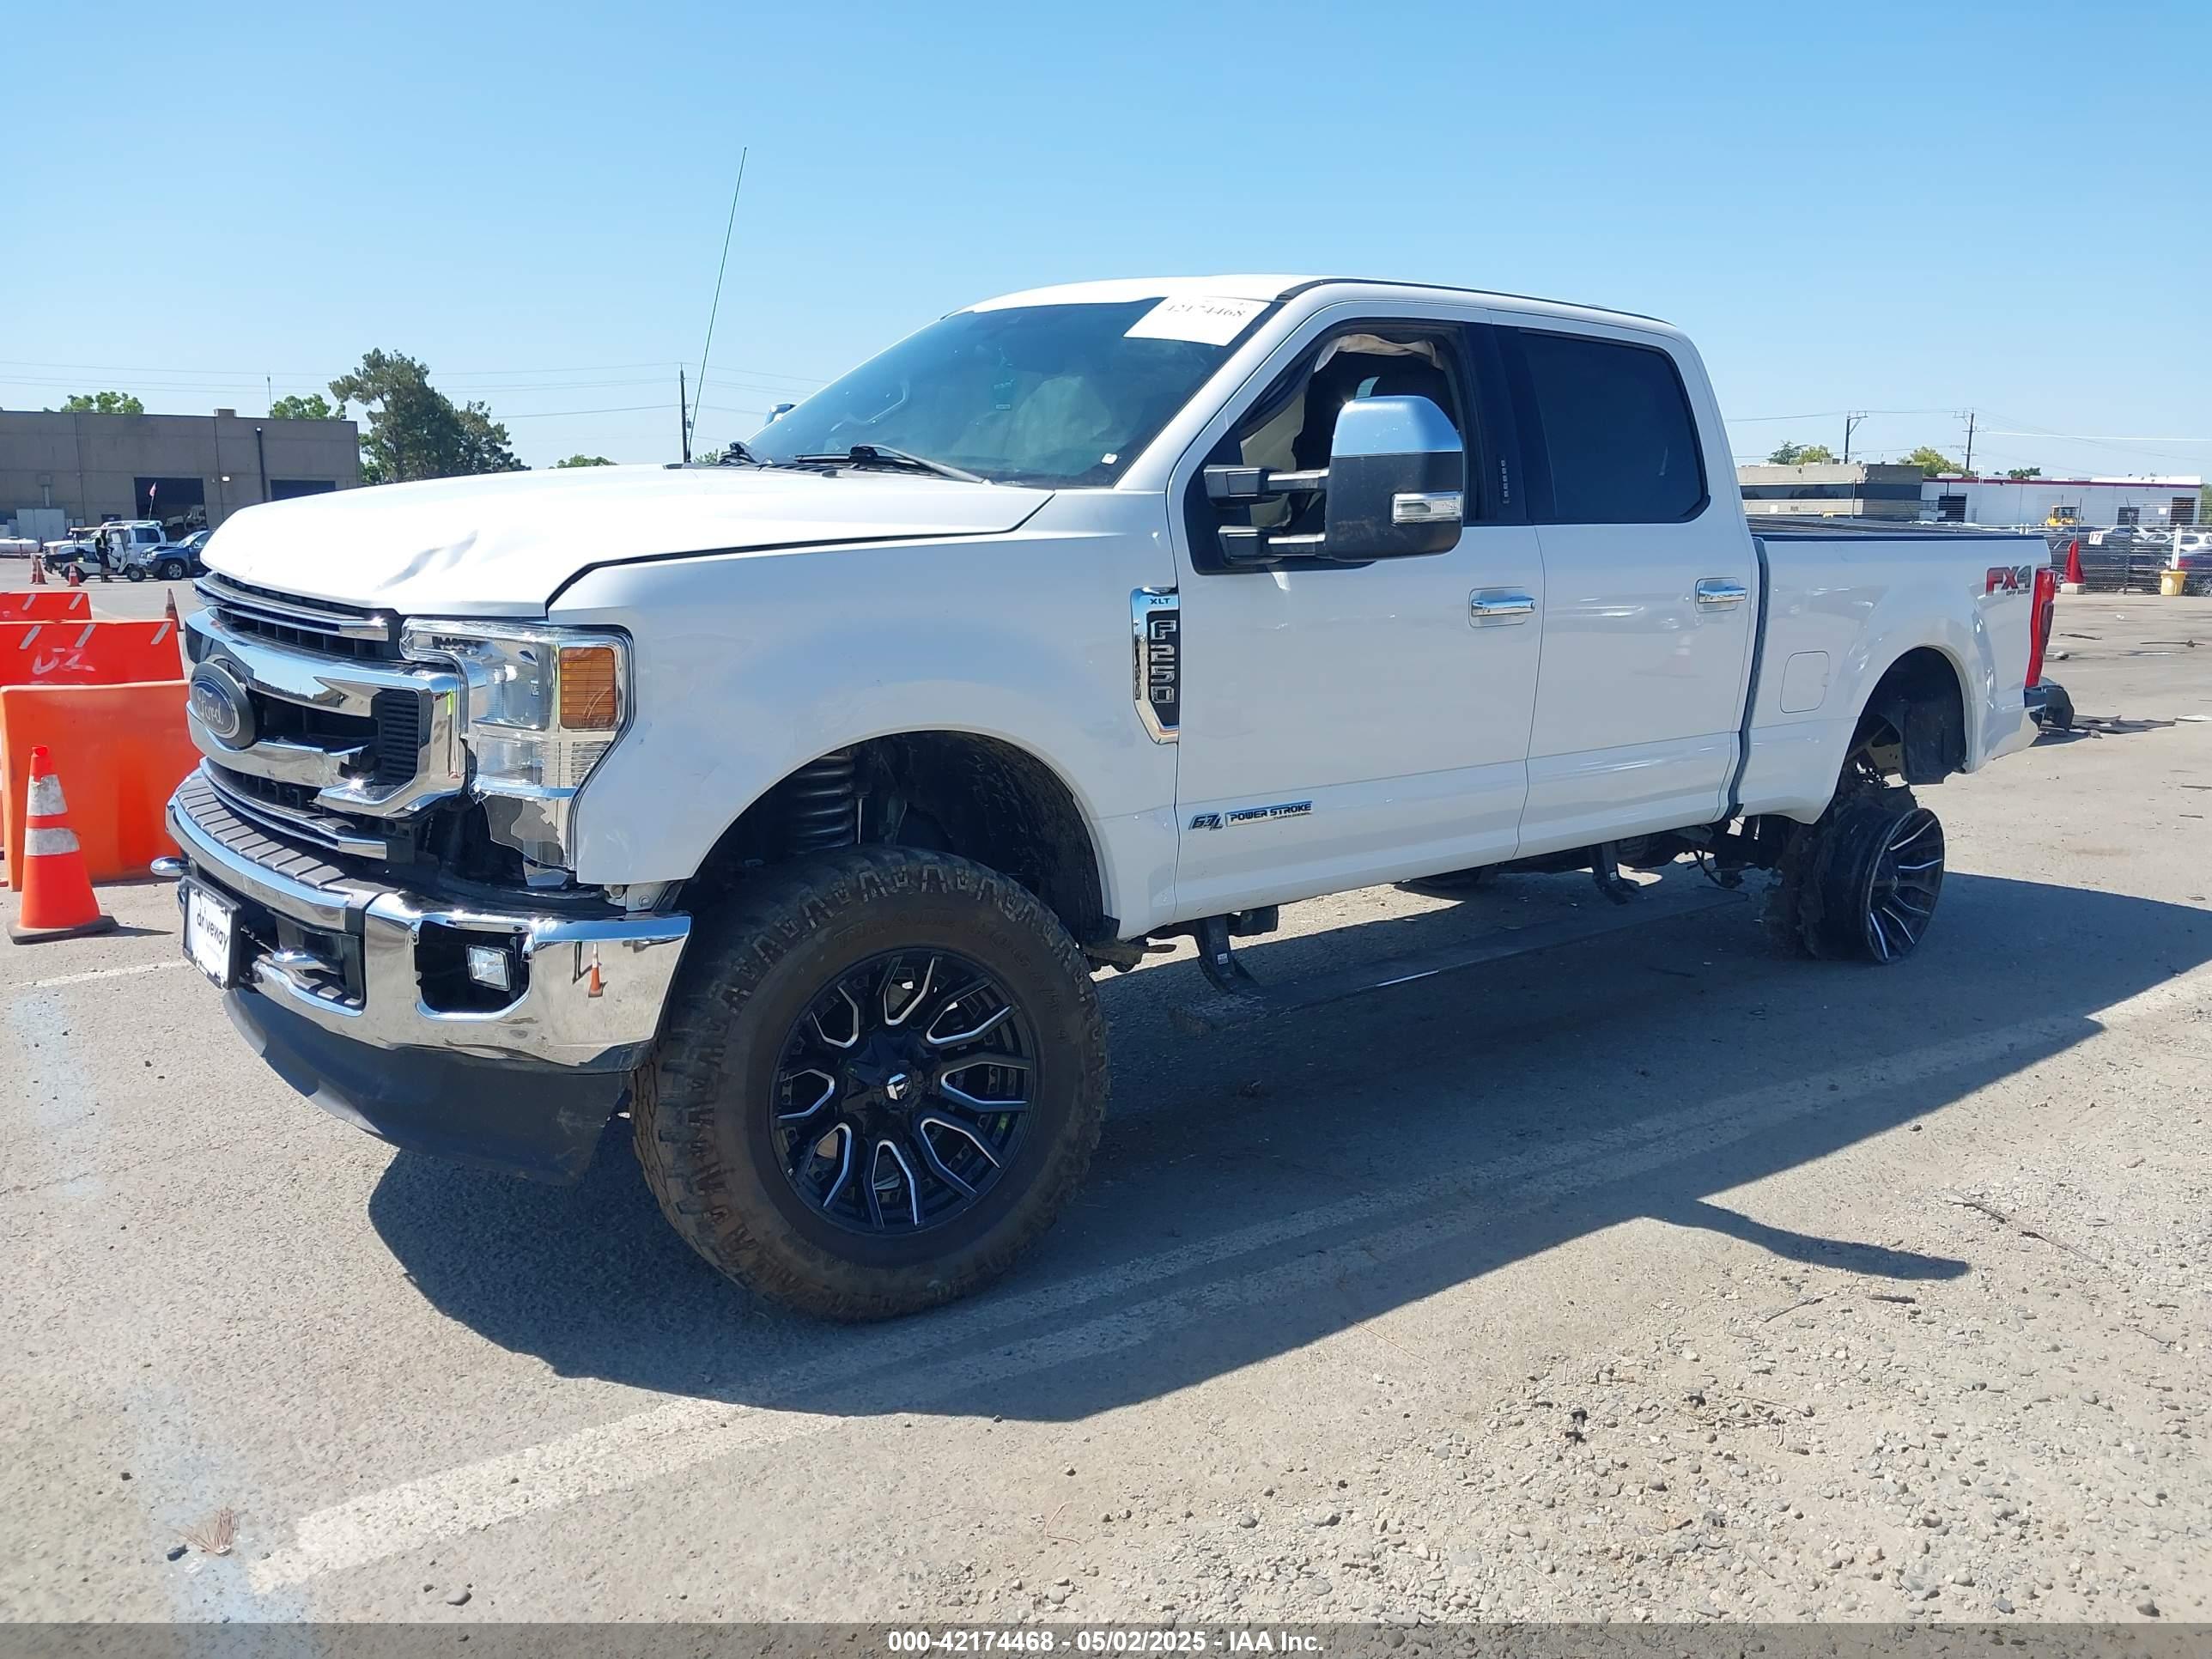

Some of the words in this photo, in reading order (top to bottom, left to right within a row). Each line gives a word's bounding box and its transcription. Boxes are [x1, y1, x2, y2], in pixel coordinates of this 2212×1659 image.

[2090, 532, 2101, 542] 17
[1986, 565, 2032, 596] FX4
[197, 687, 224, 725] Ford
[1229, 809, 1268, 822] POWER
[1270, 803, 1312, 817] STROKE
[197, 907, 230, 953] driveway
